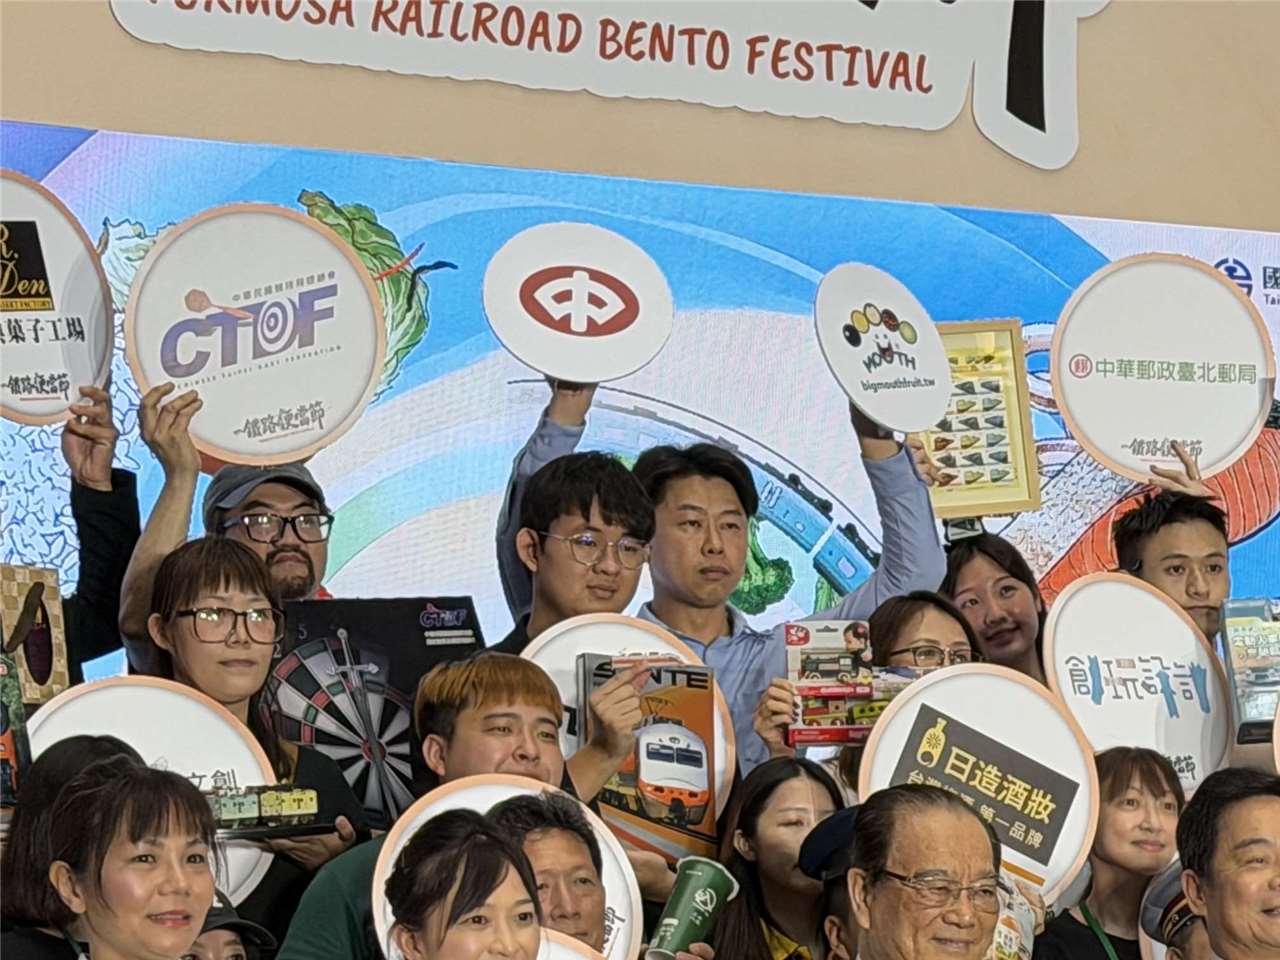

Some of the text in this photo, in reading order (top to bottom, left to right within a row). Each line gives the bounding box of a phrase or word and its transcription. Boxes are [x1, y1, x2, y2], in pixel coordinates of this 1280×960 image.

[371, 0, 583, 53] RAILROAD
[599, 18, 730, 70] BENTO
[745, 35, 934, 93] FESTIVAL
[1095, 358, 1257, 384] 中華郵政臺北郵局
[593, 662, 708, 690] SNTE
